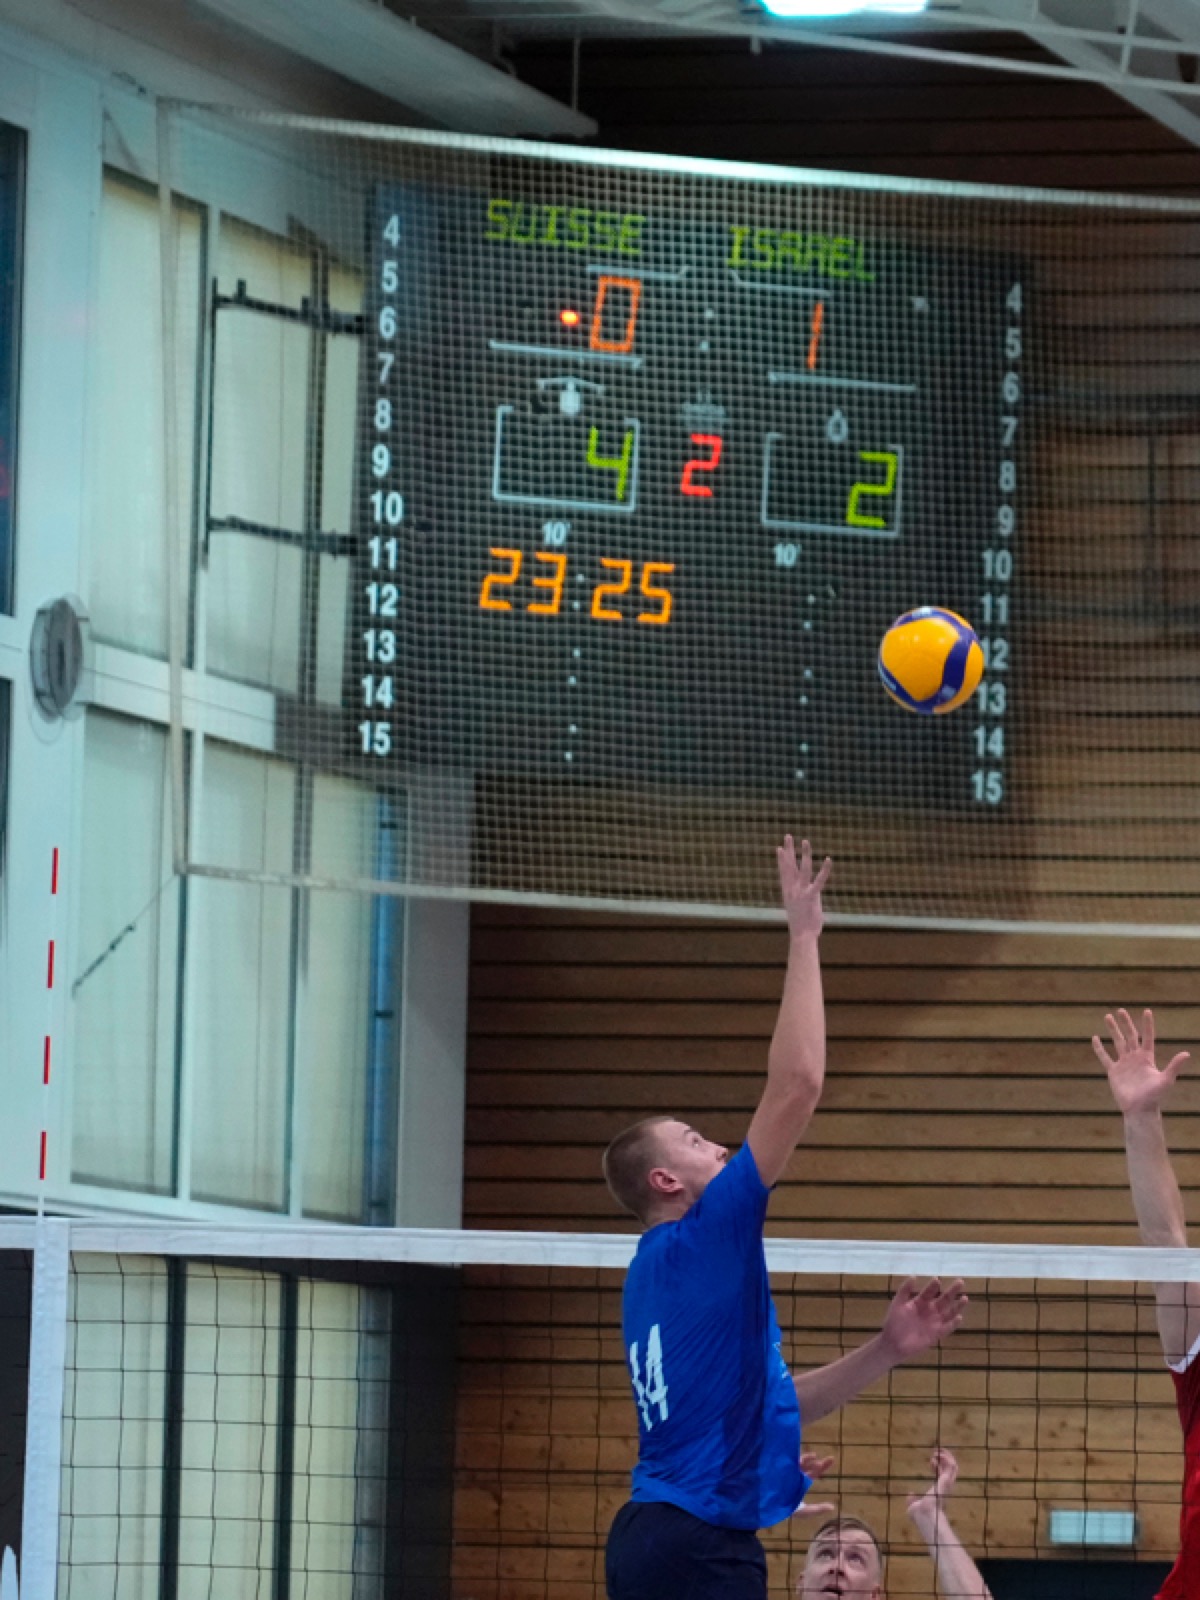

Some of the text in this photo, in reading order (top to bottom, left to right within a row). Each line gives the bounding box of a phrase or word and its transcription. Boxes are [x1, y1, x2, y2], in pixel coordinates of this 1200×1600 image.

[382, 214, 400, 247] 4
[485, 199, 648, 255] SUISSE
[381, 261, 399, 293] 5
[589, 275, 642, 353] 0
[1005, 282, 1022, 314] 4
[379, 307, 397, 340] 6
[807, 301, 824, 371] 1
[1005, 328, 1022, 360] 5
[377, 352, 395, 384] 7
[1002, 372, 1021, 404] 6
[374, 398, 392, 432] 8
[1000, 416, 1018, 448] 7
[371, 444, 391, 477] 9
[587, 425, 633, 500] 4
[680, 433, 723, 498] 2
[999, 461, 1017, 492] 8
[846, 451, 898, 528] 2
[369, 491, 404, 525] 10
[998, 505, 1016, 537] 9
[367, 535, 399, 570] 11
[982, 549, 1013, 581] 10
[365, 582, 400, 618] 12
[981, 593, 1009, 625] 11
[363, 629, 398, 664] 13
[360, 674, 394, 709] 14
[977, 682, 1007, 716] 13
[358, 720, 391, 756] 15
[973, 726, 1005, 759] 14
[970, 770, 1004, 804] 15
[629, 1323, 669, 1432] 14
